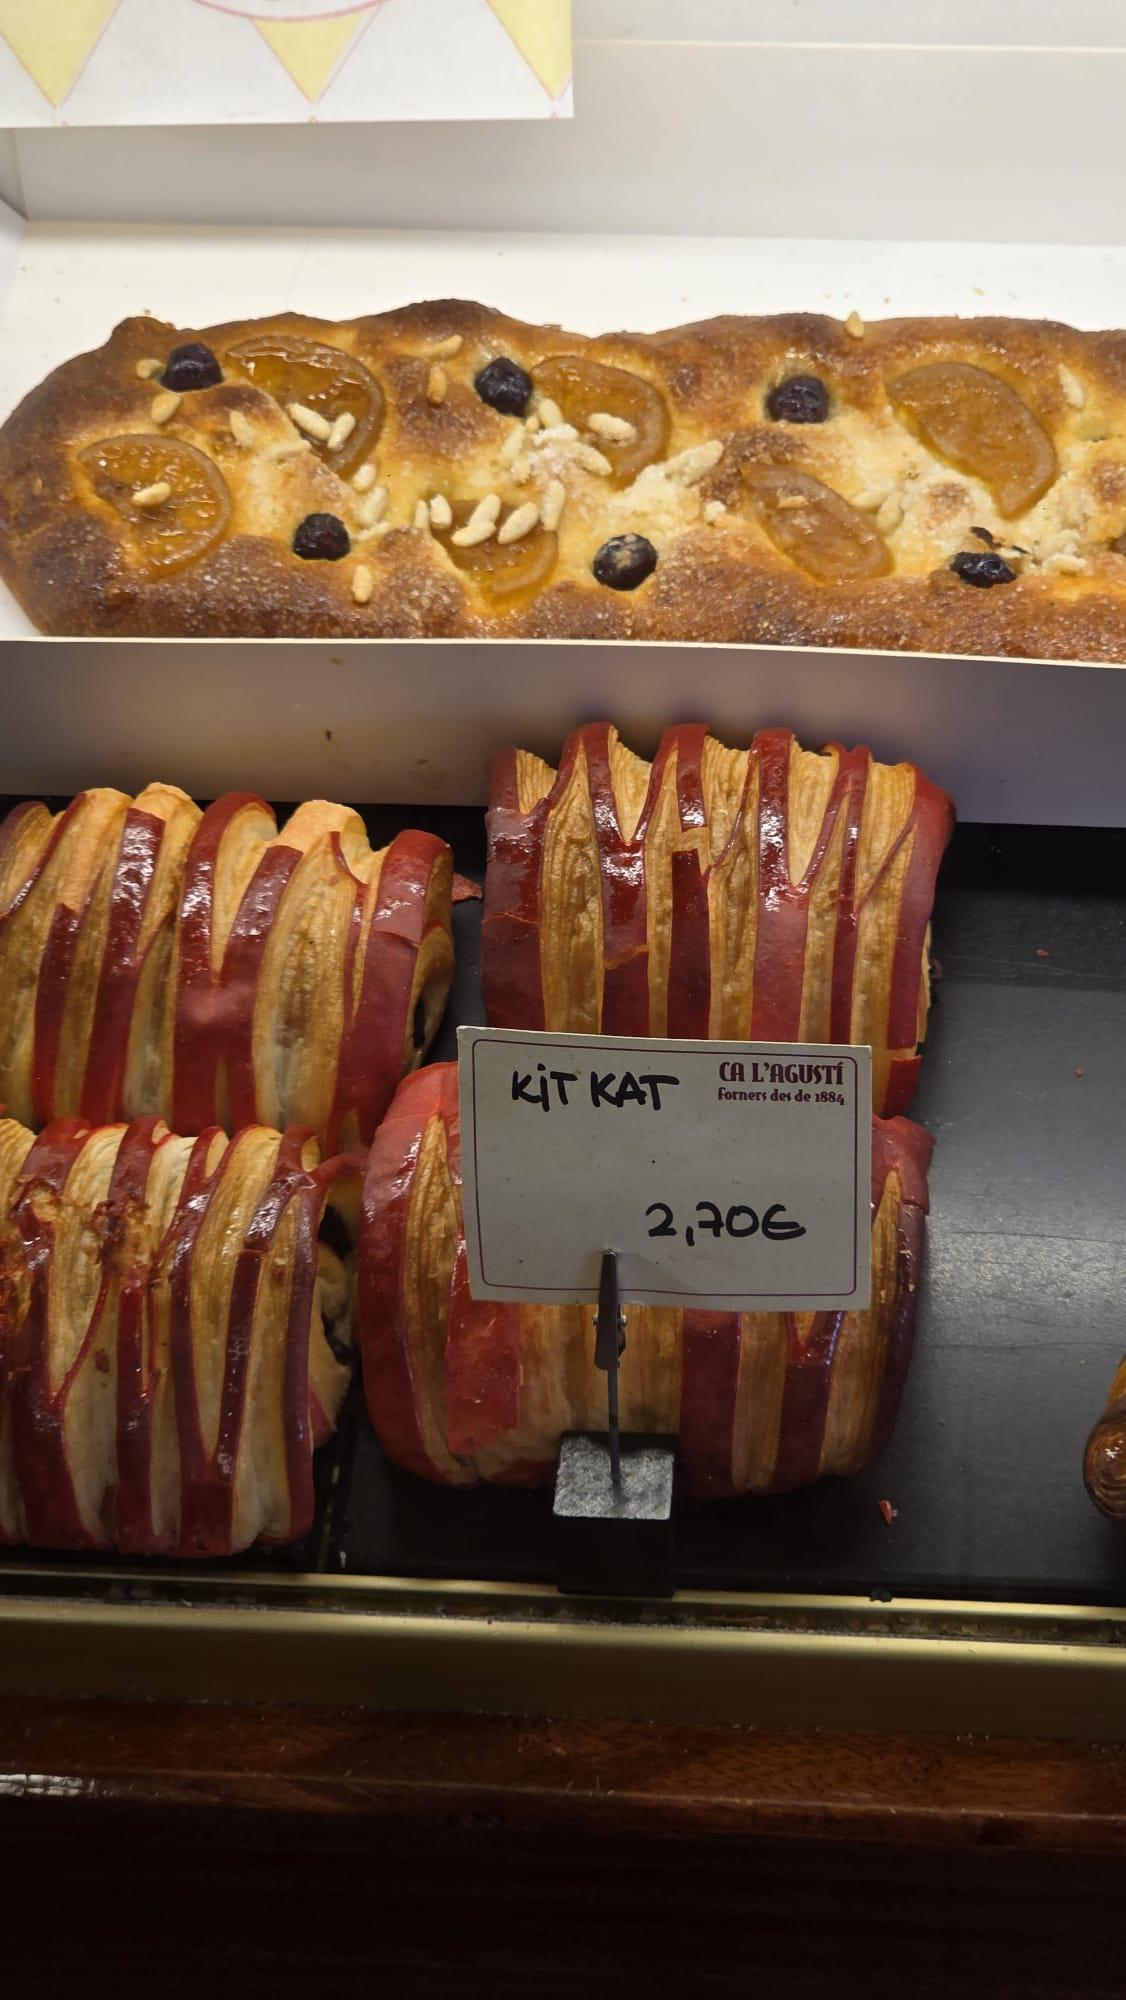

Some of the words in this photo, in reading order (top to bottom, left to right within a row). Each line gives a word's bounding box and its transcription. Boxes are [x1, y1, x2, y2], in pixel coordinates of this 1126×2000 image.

[719, 1062, 745, 1082] CA
[590, 1071, 680, 1111] KAT
[770, 1088, 792, 1102] des
[794, 1089, 811, 1103] de
[815, 1091, 845, 1106] 1884
[645, 1201, 807, 1247] 2,70€
